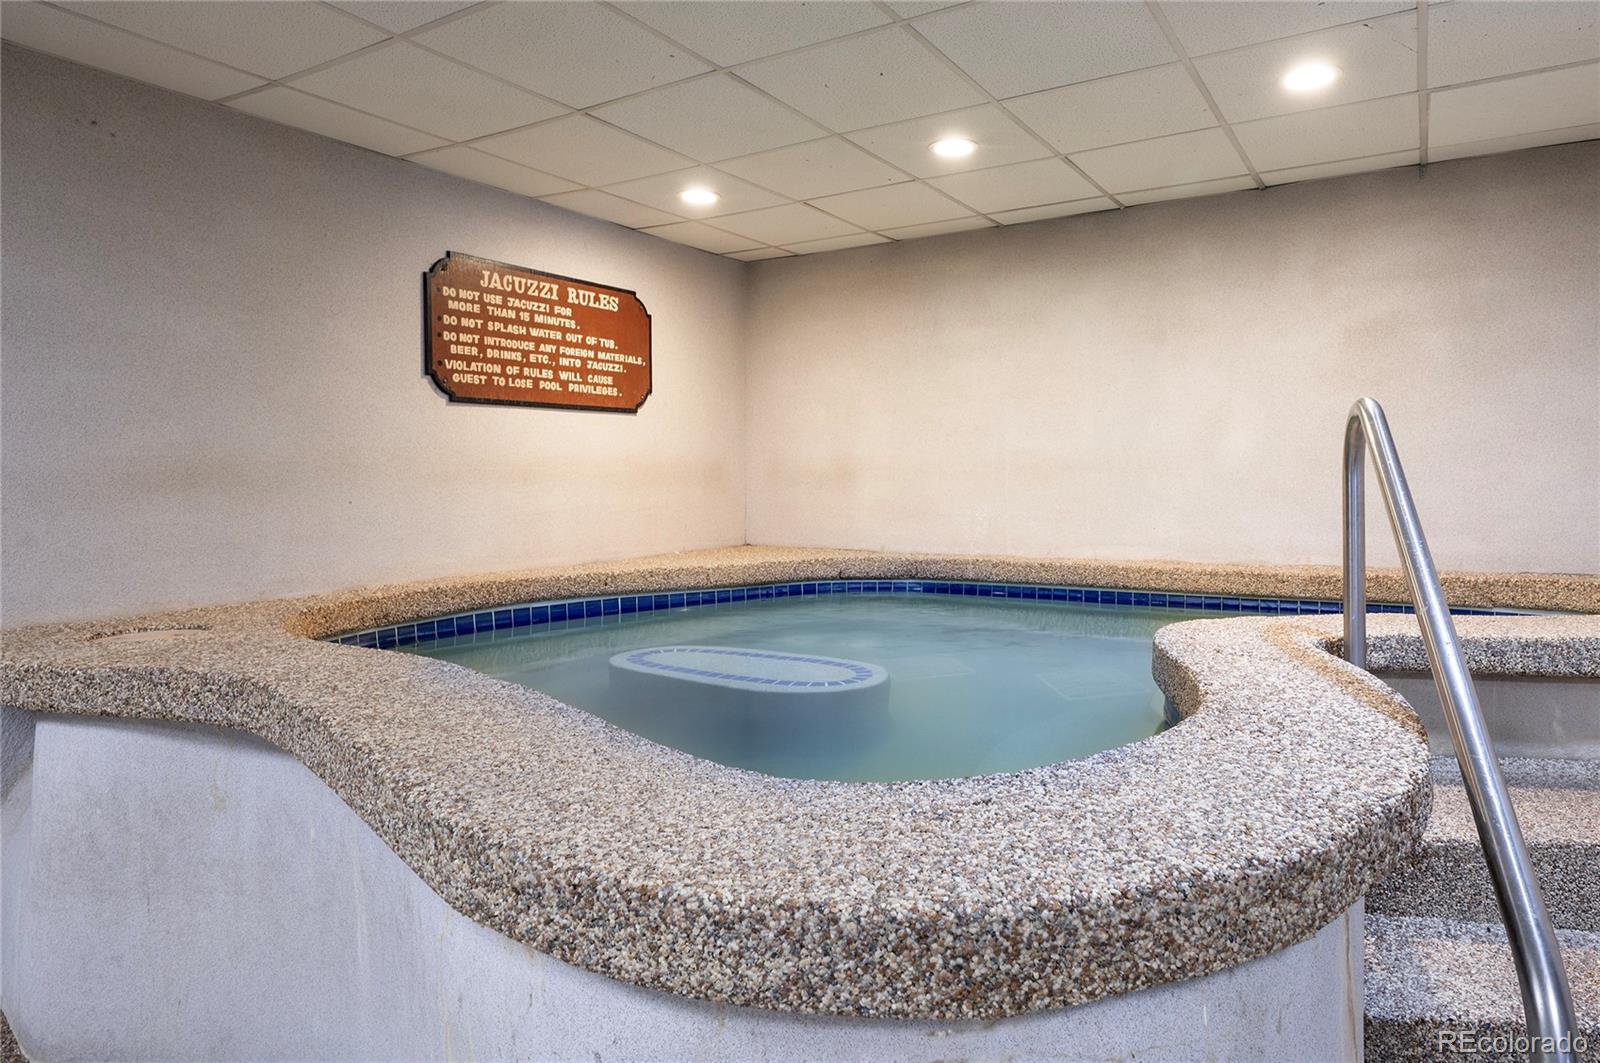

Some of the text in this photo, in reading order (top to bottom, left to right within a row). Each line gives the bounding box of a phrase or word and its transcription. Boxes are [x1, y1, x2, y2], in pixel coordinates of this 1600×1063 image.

[442, 286, 572, 317] DO NOT USE JACUZZI FOR
[480, 270, 619, 312] JACUZZI RULES
[448, 300, 580, 330] MORE THAN 15 MINUTES.
[443, 314, 618, 350] DO NOT SPLASH WATER OUT OF TUB.
[443, 330, 646, 366] DO NOT INTRODUCE ANY FOREIGN MATERIALS,
[450, 344, 627, 373] BEER, DRINKS, ETC., INTO JACUZZI.
[444, 359, 614, 385] VIOLATION OF RULES WILL CAUSE
[452, 373, 623, 397] GUEST TO LOSE POOL PRIVILEGES.
